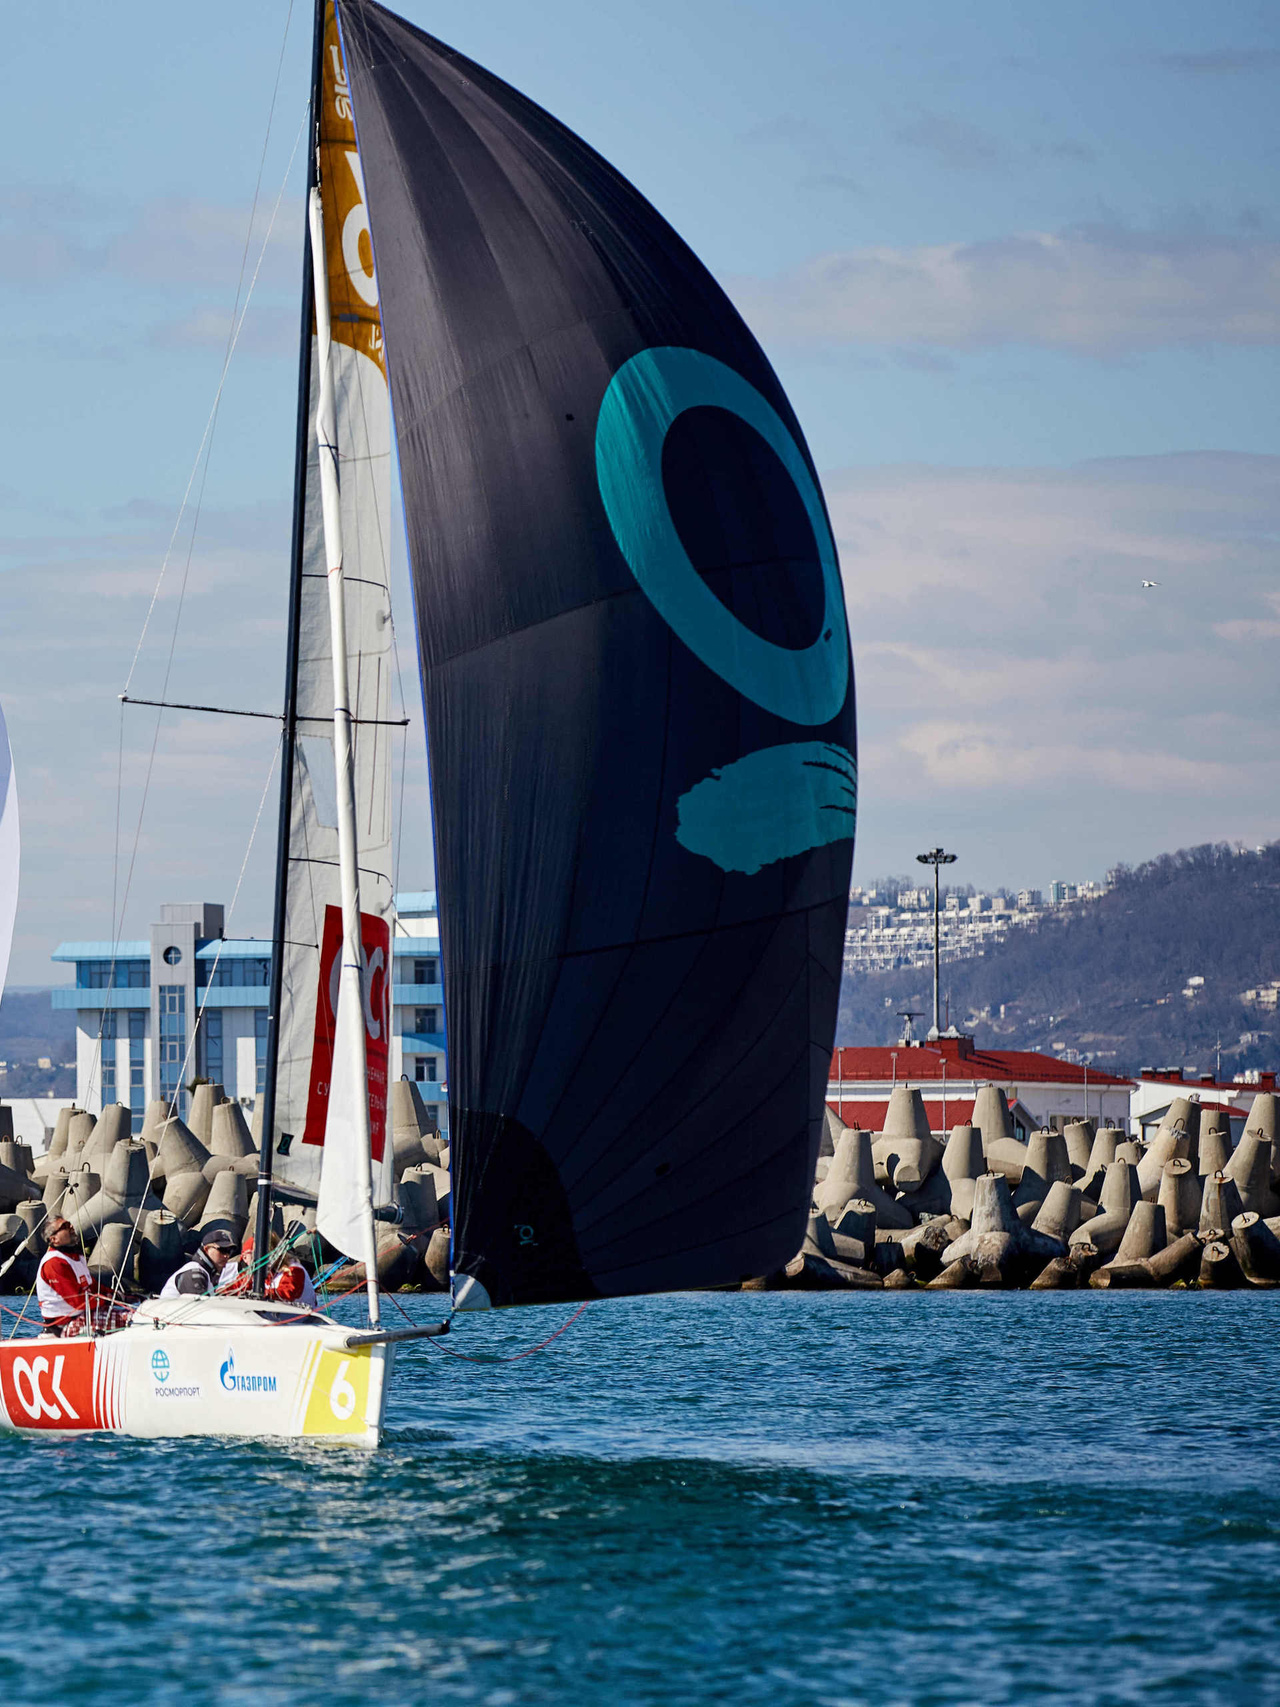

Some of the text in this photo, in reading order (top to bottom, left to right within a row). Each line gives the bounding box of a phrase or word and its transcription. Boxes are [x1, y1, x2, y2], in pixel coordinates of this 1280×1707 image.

[155, 1387, 200, 1397] РОСМОРПОРТ
[236, 1376, 277, 1392] ГАЗПРОМ
[329, 1360, 356, 1420] 6
